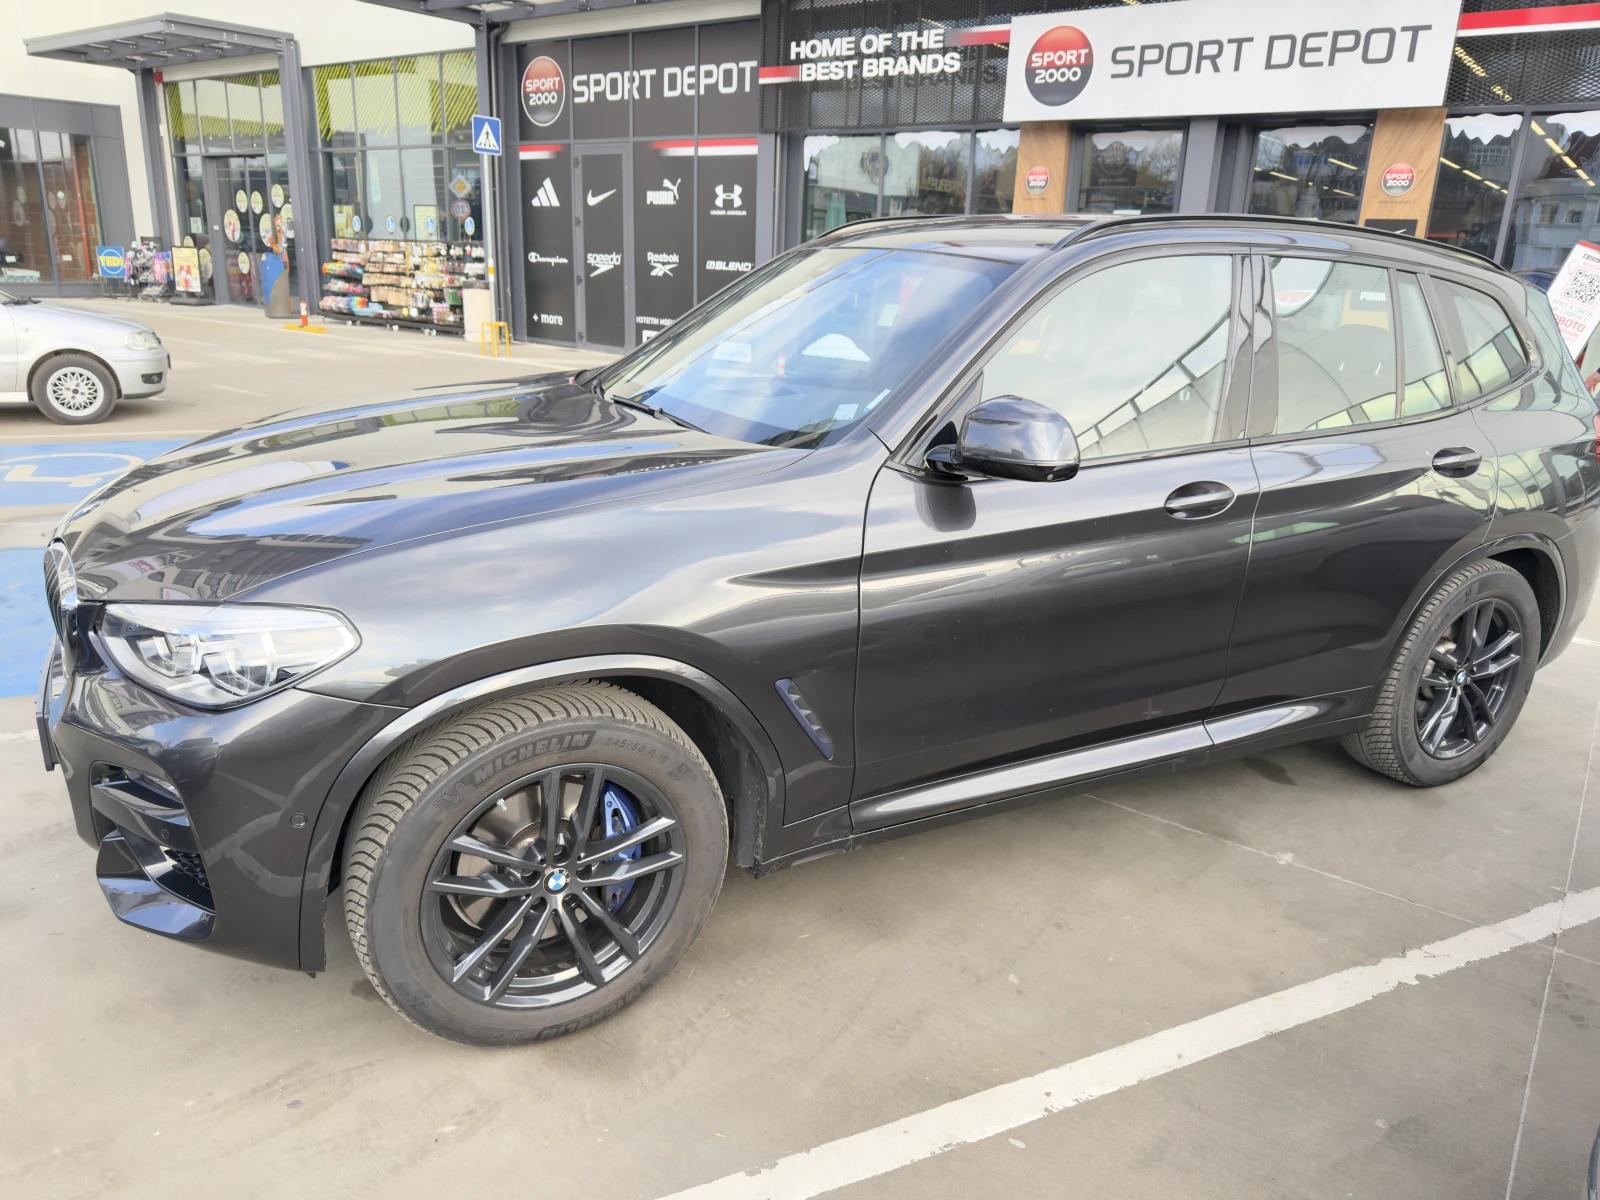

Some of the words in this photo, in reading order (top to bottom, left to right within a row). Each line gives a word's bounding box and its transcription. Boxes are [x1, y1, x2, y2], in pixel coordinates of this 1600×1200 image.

[790, 36, 856, 60] HOME
[860, 33, 892, 54] OF
[897, 28, 945, 51] THE
[1110, 36, 1254, 79] SPORT
[1264, 24, 1433, 70] DEPOT
[1031, 47, 1090, 68] SPORT
[801, 59, 857, 82] BEST
[862, 51, 961, 78] BRANDS
[573, 69, 657, 104] SPORT
[663, 60, 758, 98] DEPOT
[1034, 67, 1082, 84] 2000
[525, 76, 561, 92] SPORT
[529, 91, 558, 106] 2000
[646, 190, 676, 205] PUMA
[528, 252, 568, 266] Champion
[587, 252, 622, 266] speedo
[647, 252, 679, 263] Reebok
[715, 261, 752, 272] BLEND
[541, 313, 563, 325] more
[473, 732, 591, 785] MICHELIN
[604, 737, 646, 754] 245/50
[648, 749, 657, 758] R
[657, 753, 669, 764] 19
